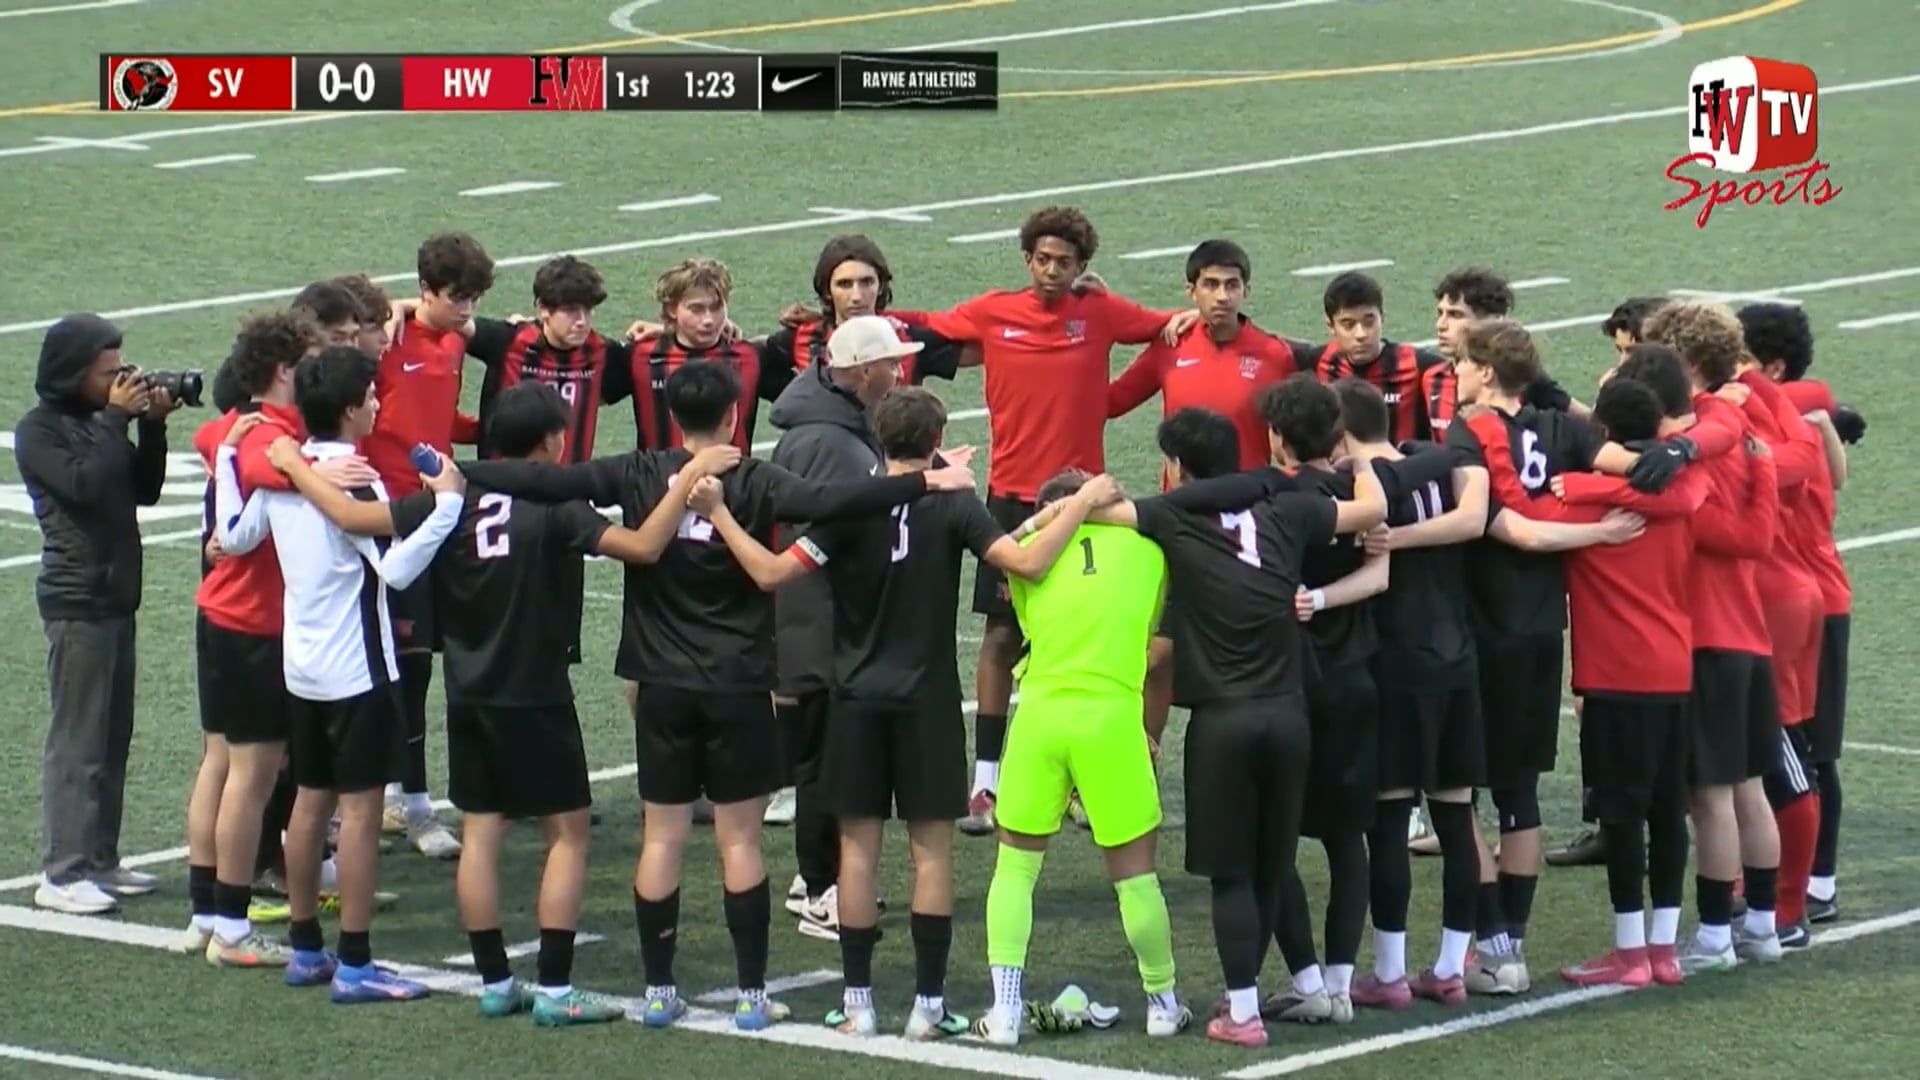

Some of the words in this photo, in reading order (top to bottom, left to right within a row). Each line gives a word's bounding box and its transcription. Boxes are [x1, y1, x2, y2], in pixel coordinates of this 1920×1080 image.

[1519, 429, 1547, 490] 6
[475, 493, 513, 560] 2
[890, 503, 909, 563] 3
[1078, 536, 1099, 576] 1
[1219, 508, 1261, 569] 7
